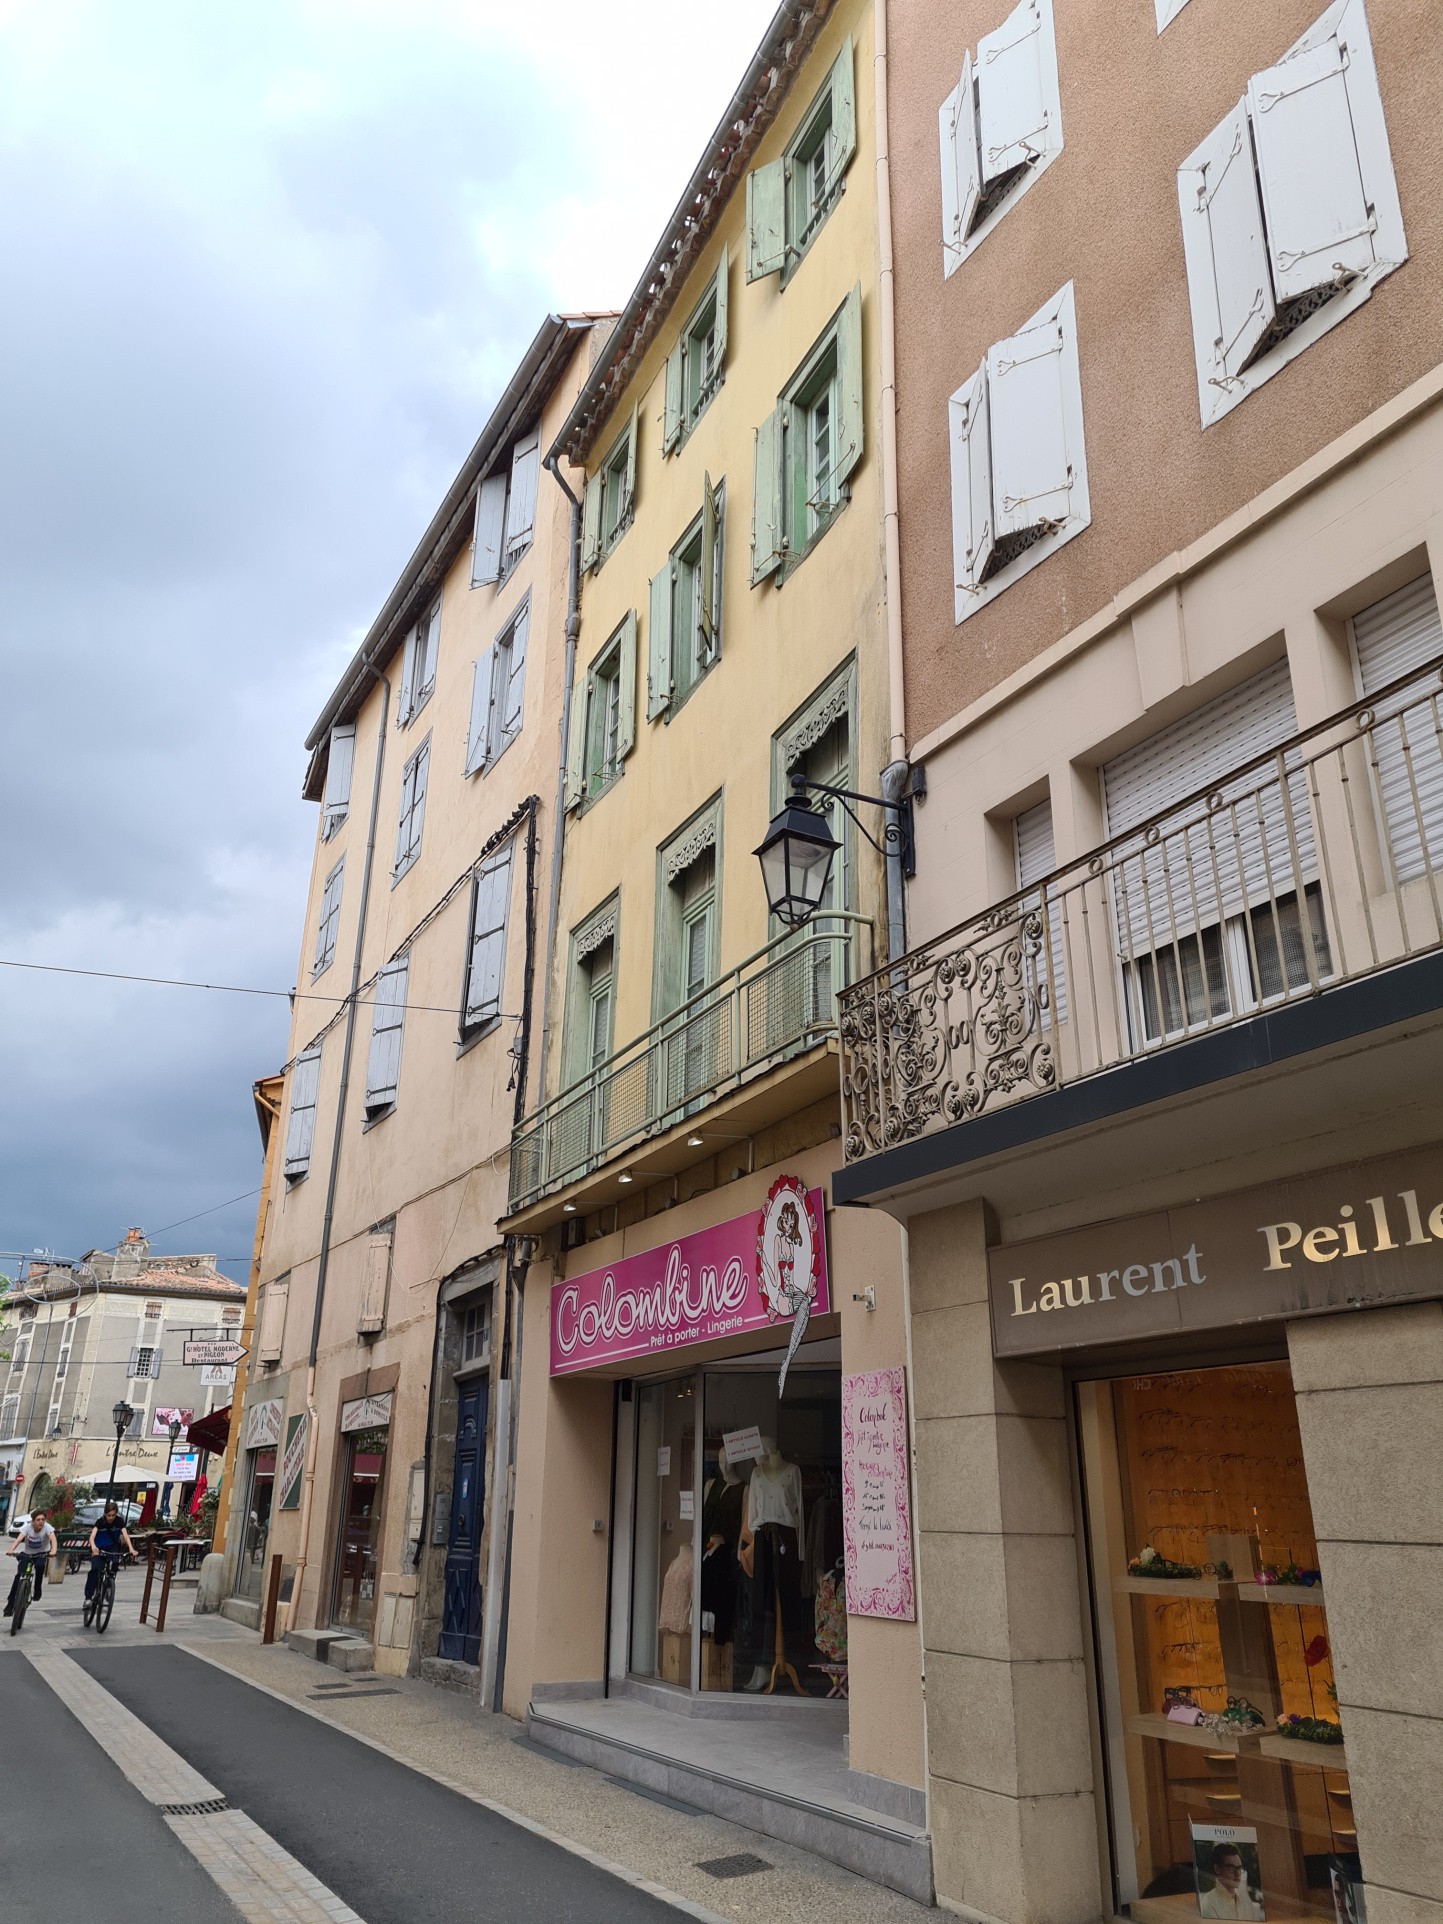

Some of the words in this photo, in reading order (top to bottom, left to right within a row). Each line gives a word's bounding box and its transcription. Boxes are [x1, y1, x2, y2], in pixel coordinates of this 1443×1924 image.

[558, 1245, 748, 1355] Colombine
[1008, 1242, 1206, 1316] Laurent
[650, 1332, 665, 1348] Prêt
[667, 1331, 673, 1344] à
[675, 1326, 700, 1344] porter
[707, 1315, 743, 1336] Lingerie
[1214, 1828, 1235, 1836] POLO
